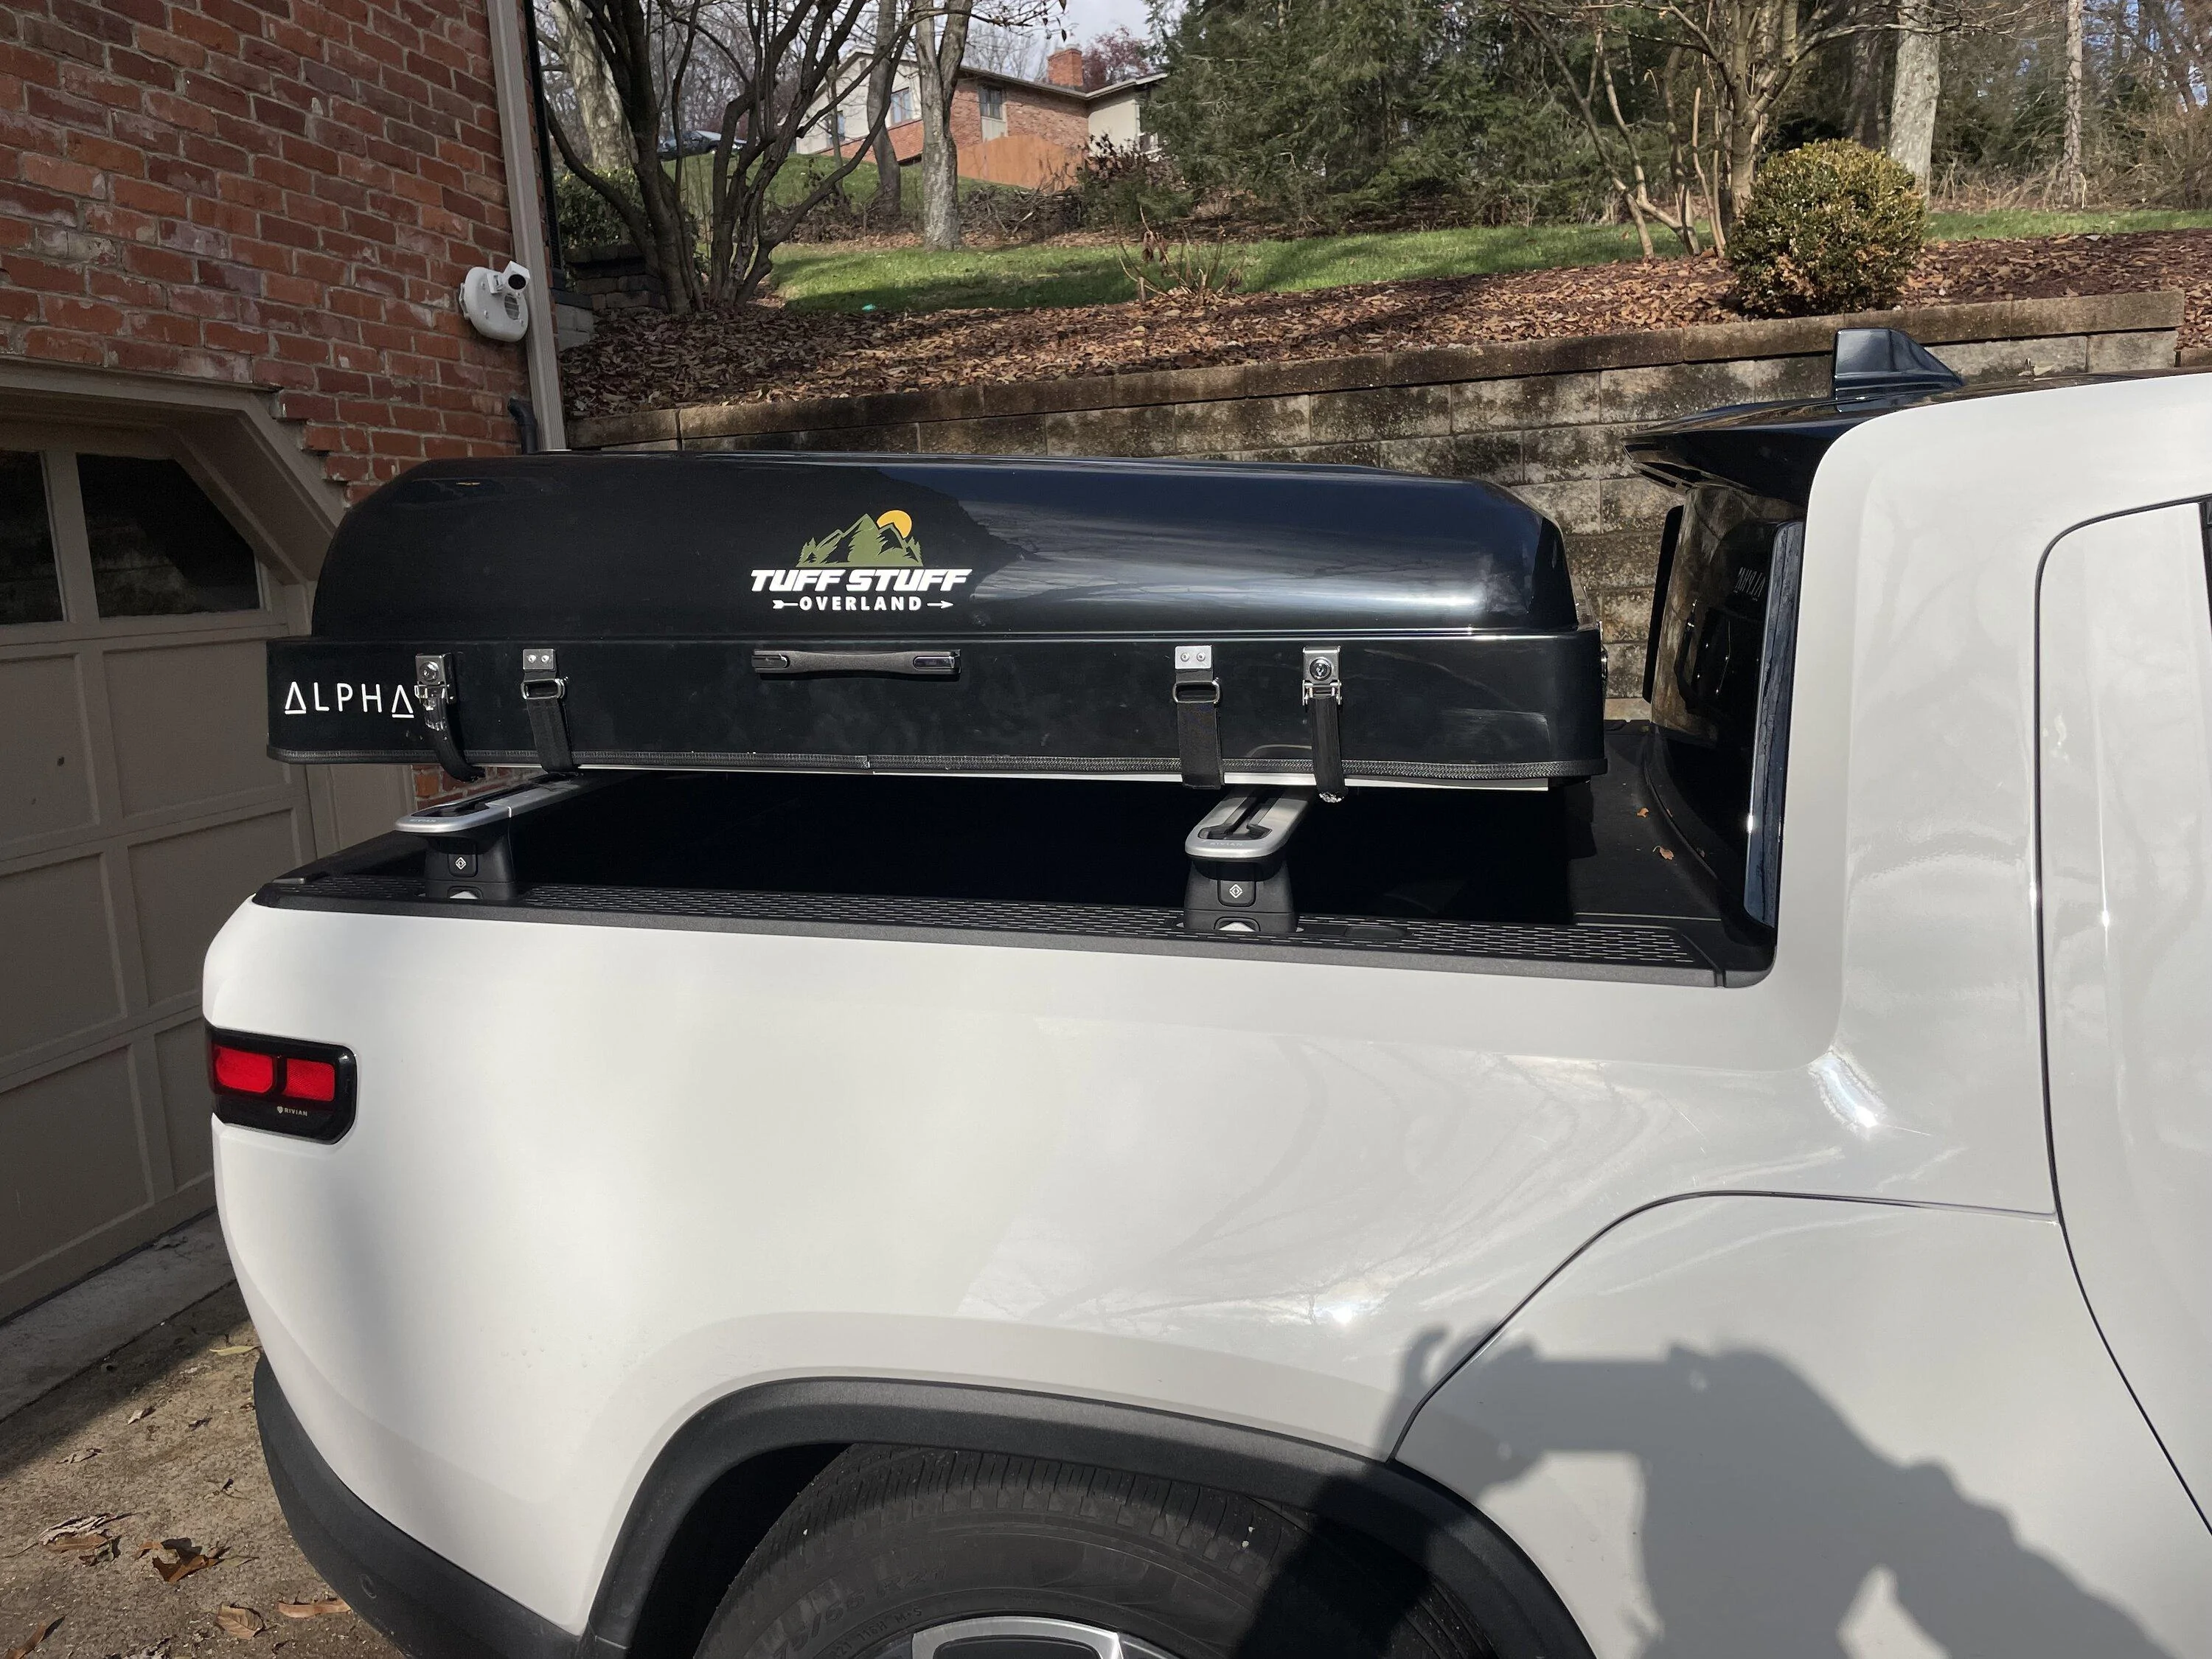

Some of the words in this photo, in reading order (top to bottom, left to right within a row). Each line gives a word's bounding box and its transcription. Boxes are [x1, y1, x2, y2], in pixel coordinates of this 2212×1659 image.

[751, 568, 846, 592] TUFF
[846, 568, 973, 592] STUFF
[799, 596, 922, 611] OVERLAND
[285, 681, 414, 718] ALPHA
[284, 1107, 307, 1116] RIVIAN
